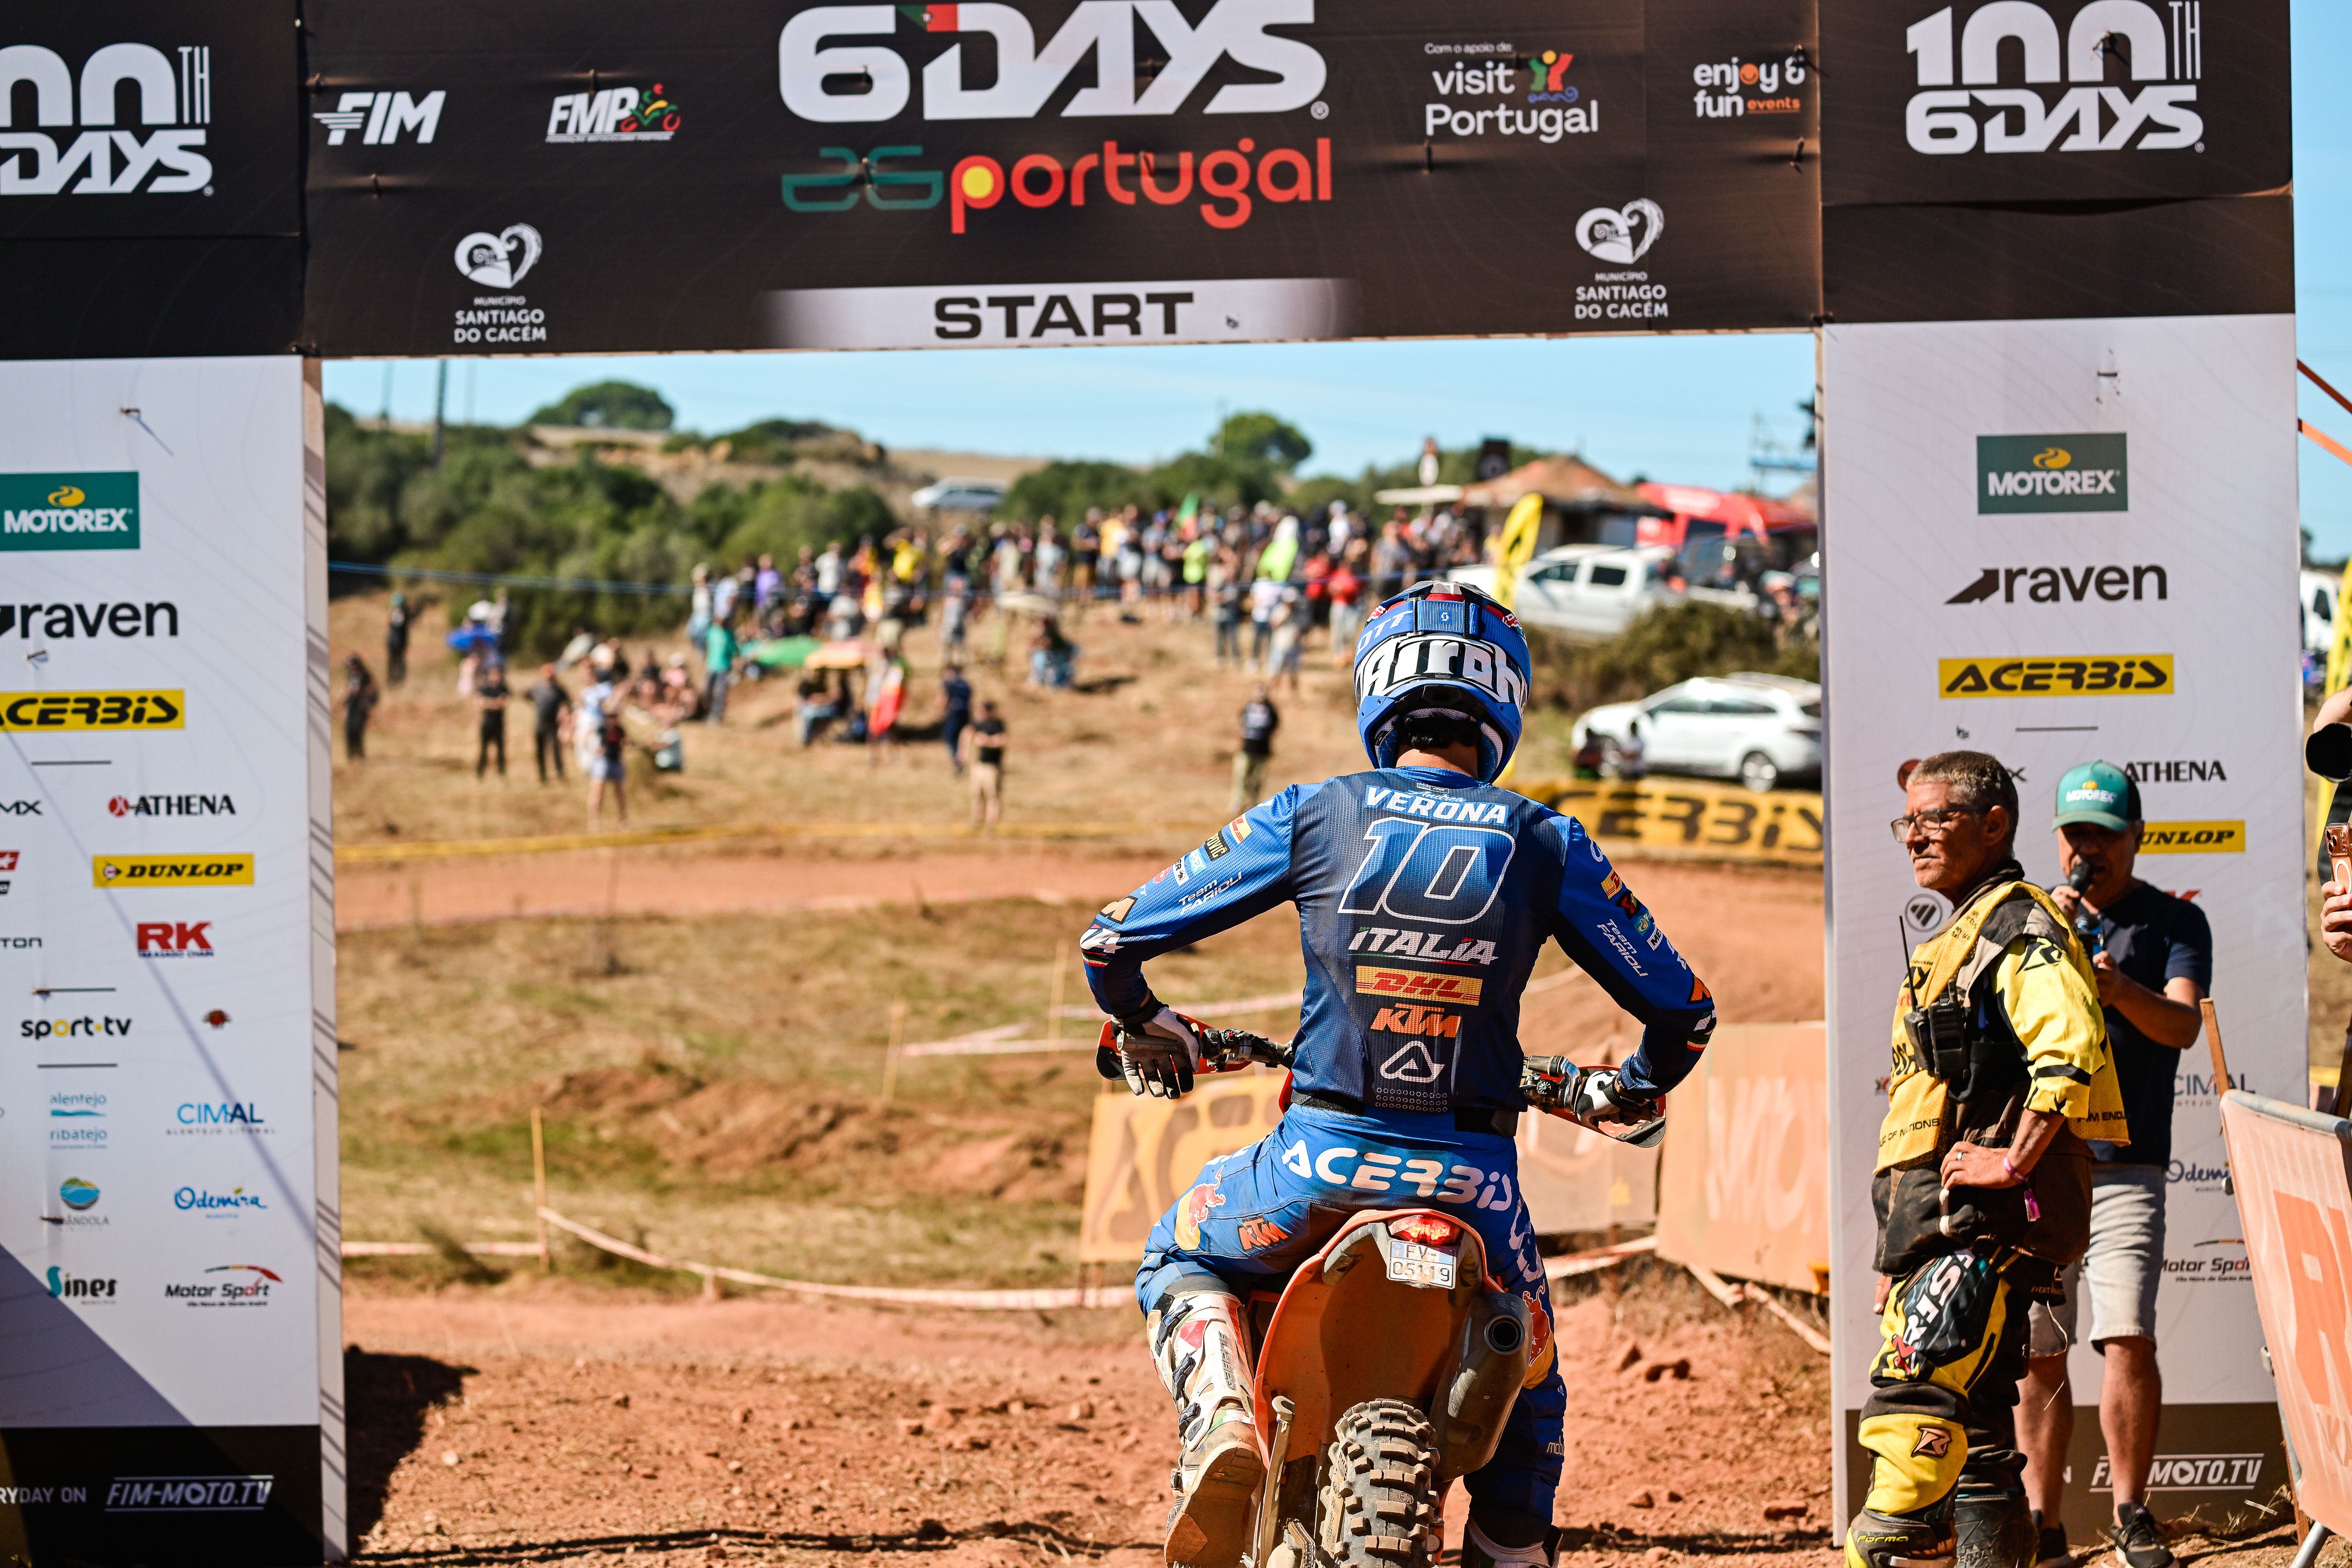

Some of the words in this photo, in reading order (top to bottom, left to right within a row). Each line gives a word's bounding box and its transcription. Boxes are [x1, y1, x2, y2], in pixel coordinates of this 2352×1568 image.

[1432, 61, 1516, 95] visit
[1693, 56, 1779, 94] enjoy
[313, 90, 447, 145] FIM
[547, 86, 640, 135] FMP
[1693, 89, 1744, 118] fun
[1747, 96, 1801, 110] events
[1425, 99, 1599, 143] Portugal
[1575, 284, 1667, 301] SANTIAGO
[455, 309, 545, 326] SANTIAGO
[935, 291, 1194, 340] START
[1574, 304, 1602, 320] DO
[1606, 300, 1669, 319] CACÉM
[454, 327, 481, 343] DO
[485, 324, 547, 343] CACÉM
[1988, 470, 2116, 496] MOTOREX
[4, 508, 129, 533] MOTOREX
[2004, 565, 2167, 603] raven
[20, 602, 179, 638] raven
[0, 695, 179, 726] CERBIS
[2123, 760, 2228, 782] ATHENA
[134, 794, 237, 816] ATHENA
[1366, 786, 1508, 825] VERONA
[2140, 830, 2235, 845] UNLOP
[126, 863, 244, 878] DUNLOP
[1337, 816, 1516, 925] 10
[1178, 879, 1218, 905] Team
[1179, 871, 1242, 915] FARIOLI
[137, 921, 213, 950] RK
[1607, 919, 1638, 955] Team
[1374, 971, 1466, 999] DHL
[1370, 1003, 1464, 1038] KTM
[50, 1092, 107, 1108] alentejo
[177, 1102, 264, 1124] CIMAL
[50, 1128, 107, 1143] ribatejo
[173, 1186, 270, 1210] Odemira
[1238, 1217, 1289, 1251] KTM
[46, 1266, 117, 1298] Sines
[165, 1283, 217, 1298] Motor
[221, 1283, 270, 1300] Sport
[61, 1487, 87, 1503] ON
[106, 1482, 273, 1506] FIM-MOTO.TV
